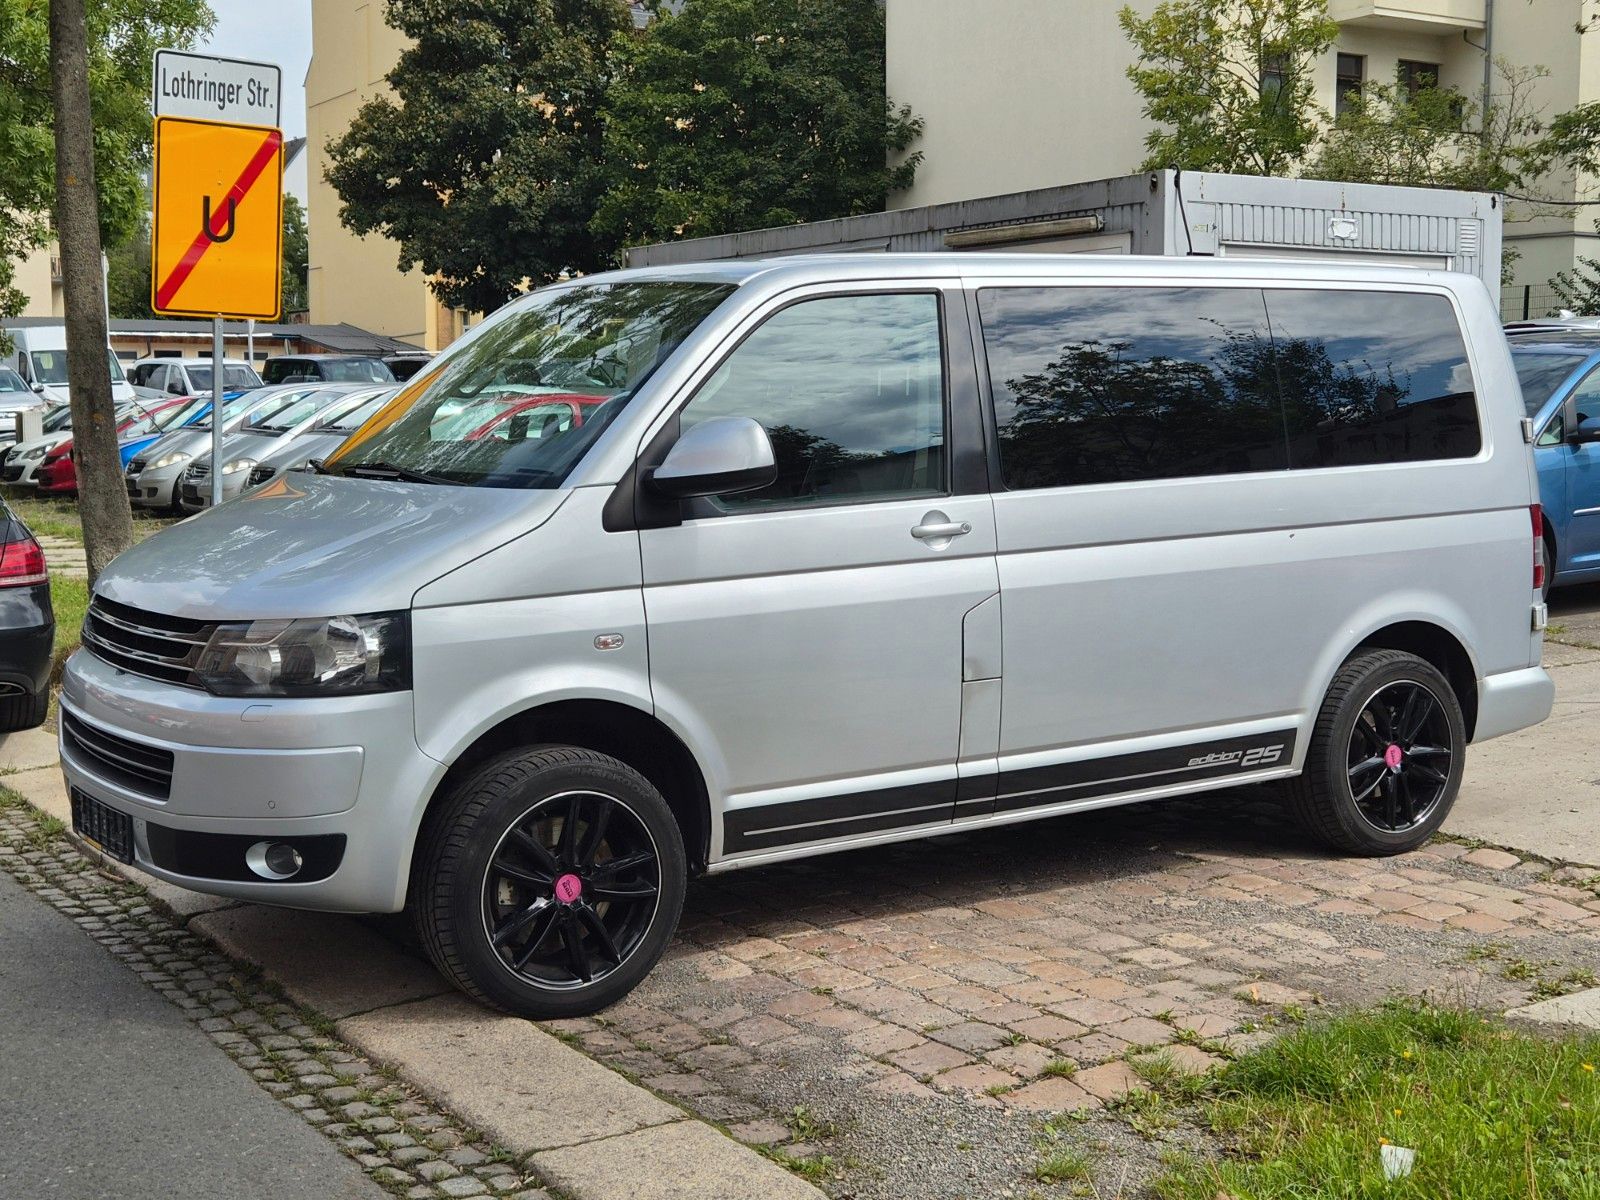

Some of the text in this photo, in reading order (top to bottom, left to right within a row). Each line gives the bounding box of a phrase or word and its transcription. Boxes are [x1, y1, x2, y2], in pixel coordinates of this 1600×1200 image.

[162, 67, 274, 110] Lothringer Str.
[202, 195, 236, 243] U
[1187, 743, 1285, 766] edition 25
